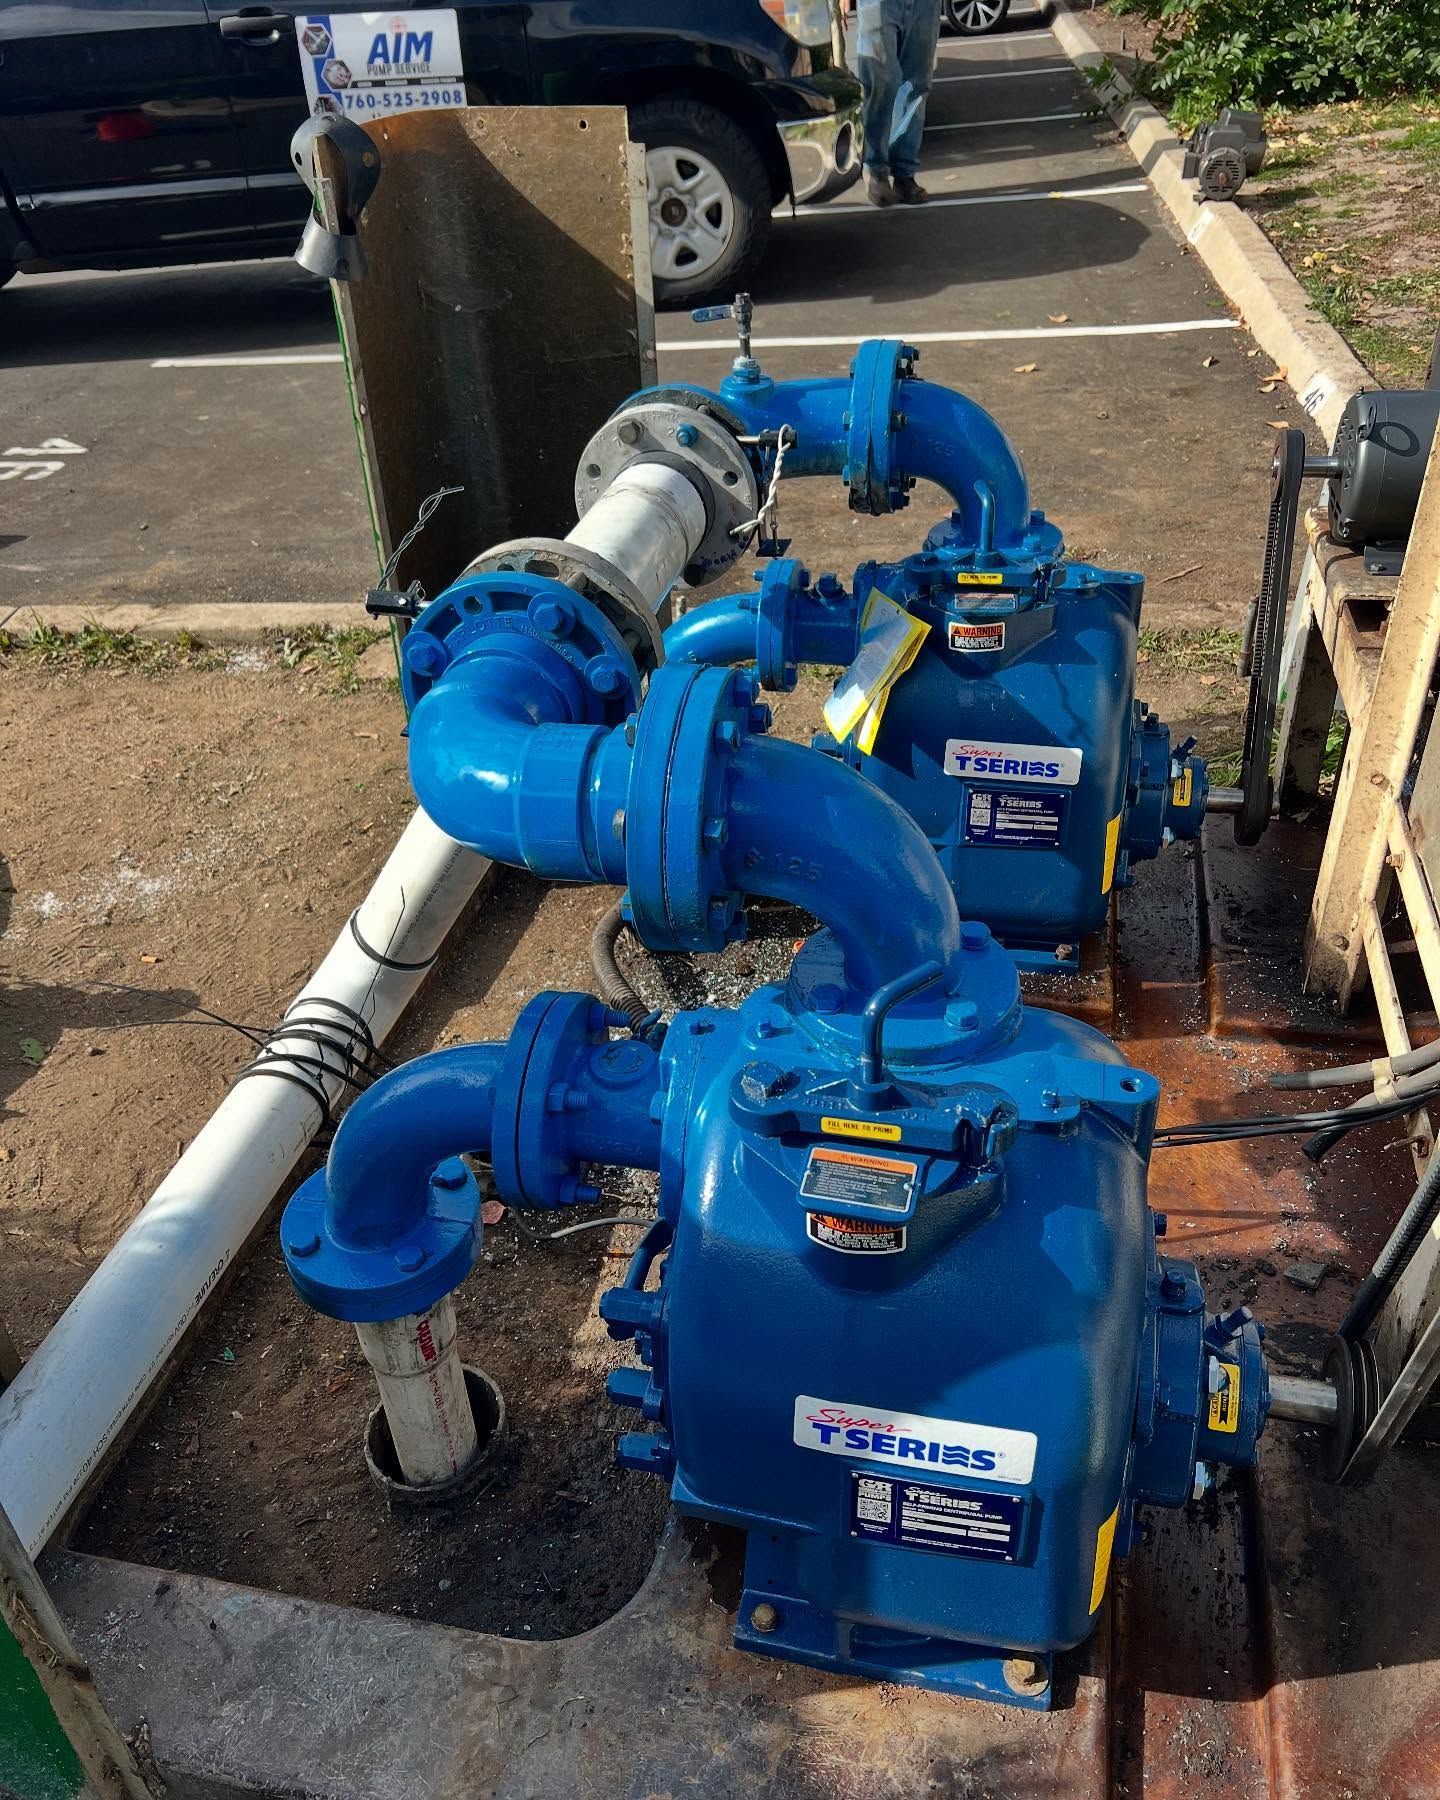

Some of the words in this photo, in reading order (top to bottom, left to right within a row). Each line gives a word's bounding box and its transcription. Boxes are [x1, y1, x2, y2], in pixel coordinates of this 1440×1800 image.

[367, 31, 433, 65] AIM
[367, 64, 392, 76] PUMP
[395, 62, 432, 75] SERVICE
[345, 90, 463, 110] 760-525-2908
[963, 625, 1002, 636] WARNING
[952, 744, 1013, 758] Super
[828, 1120, 840, 1128] FILL
[843, 1122, 858, 1130] HERE
[873, 1126, 893, 1134] PRIME
[850, 1155, 889, 1168] WARNING
[832, 1216, 898, 1233] WARNIN
[805, 1408, 912, 1433] Super
